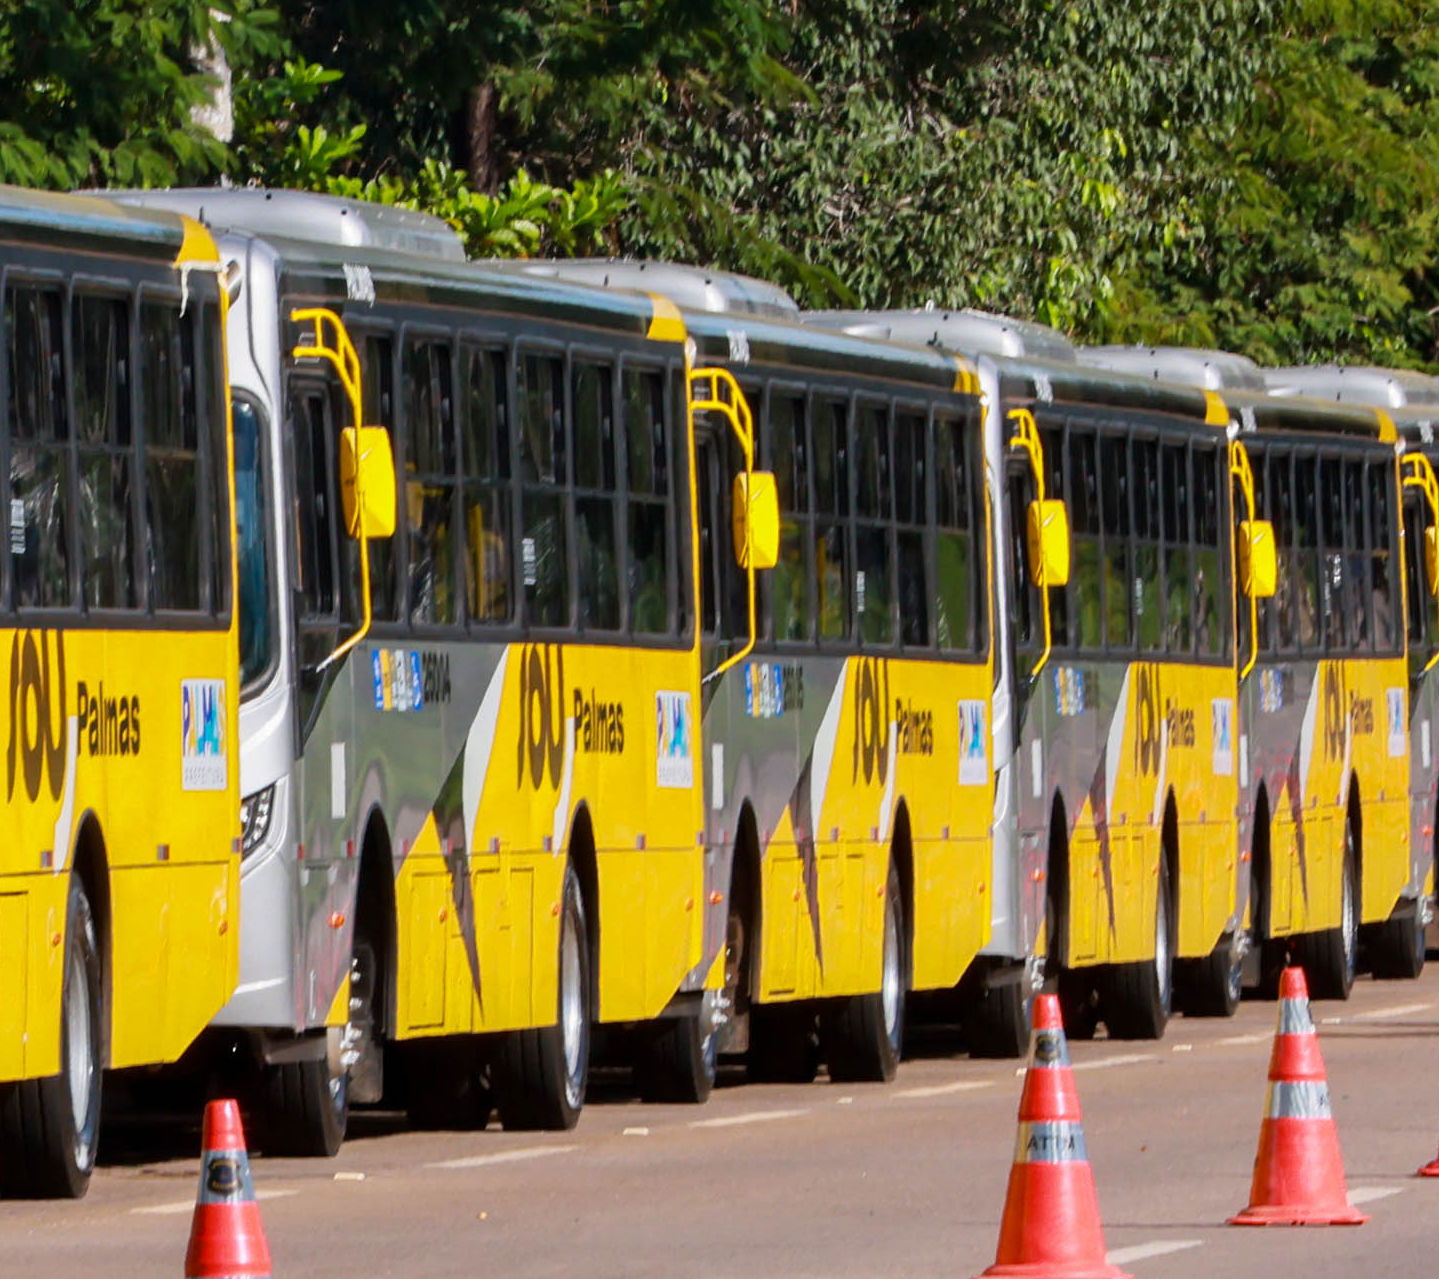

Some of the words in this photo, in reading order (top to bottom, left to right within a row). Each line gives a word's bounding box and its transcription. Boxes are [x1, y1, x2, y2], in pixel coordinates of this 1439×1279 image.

[77, 681, 140, 757] Palmas
[573, 687, 624, 755] Palmas
[896, 698, 933, 756] Palmas
